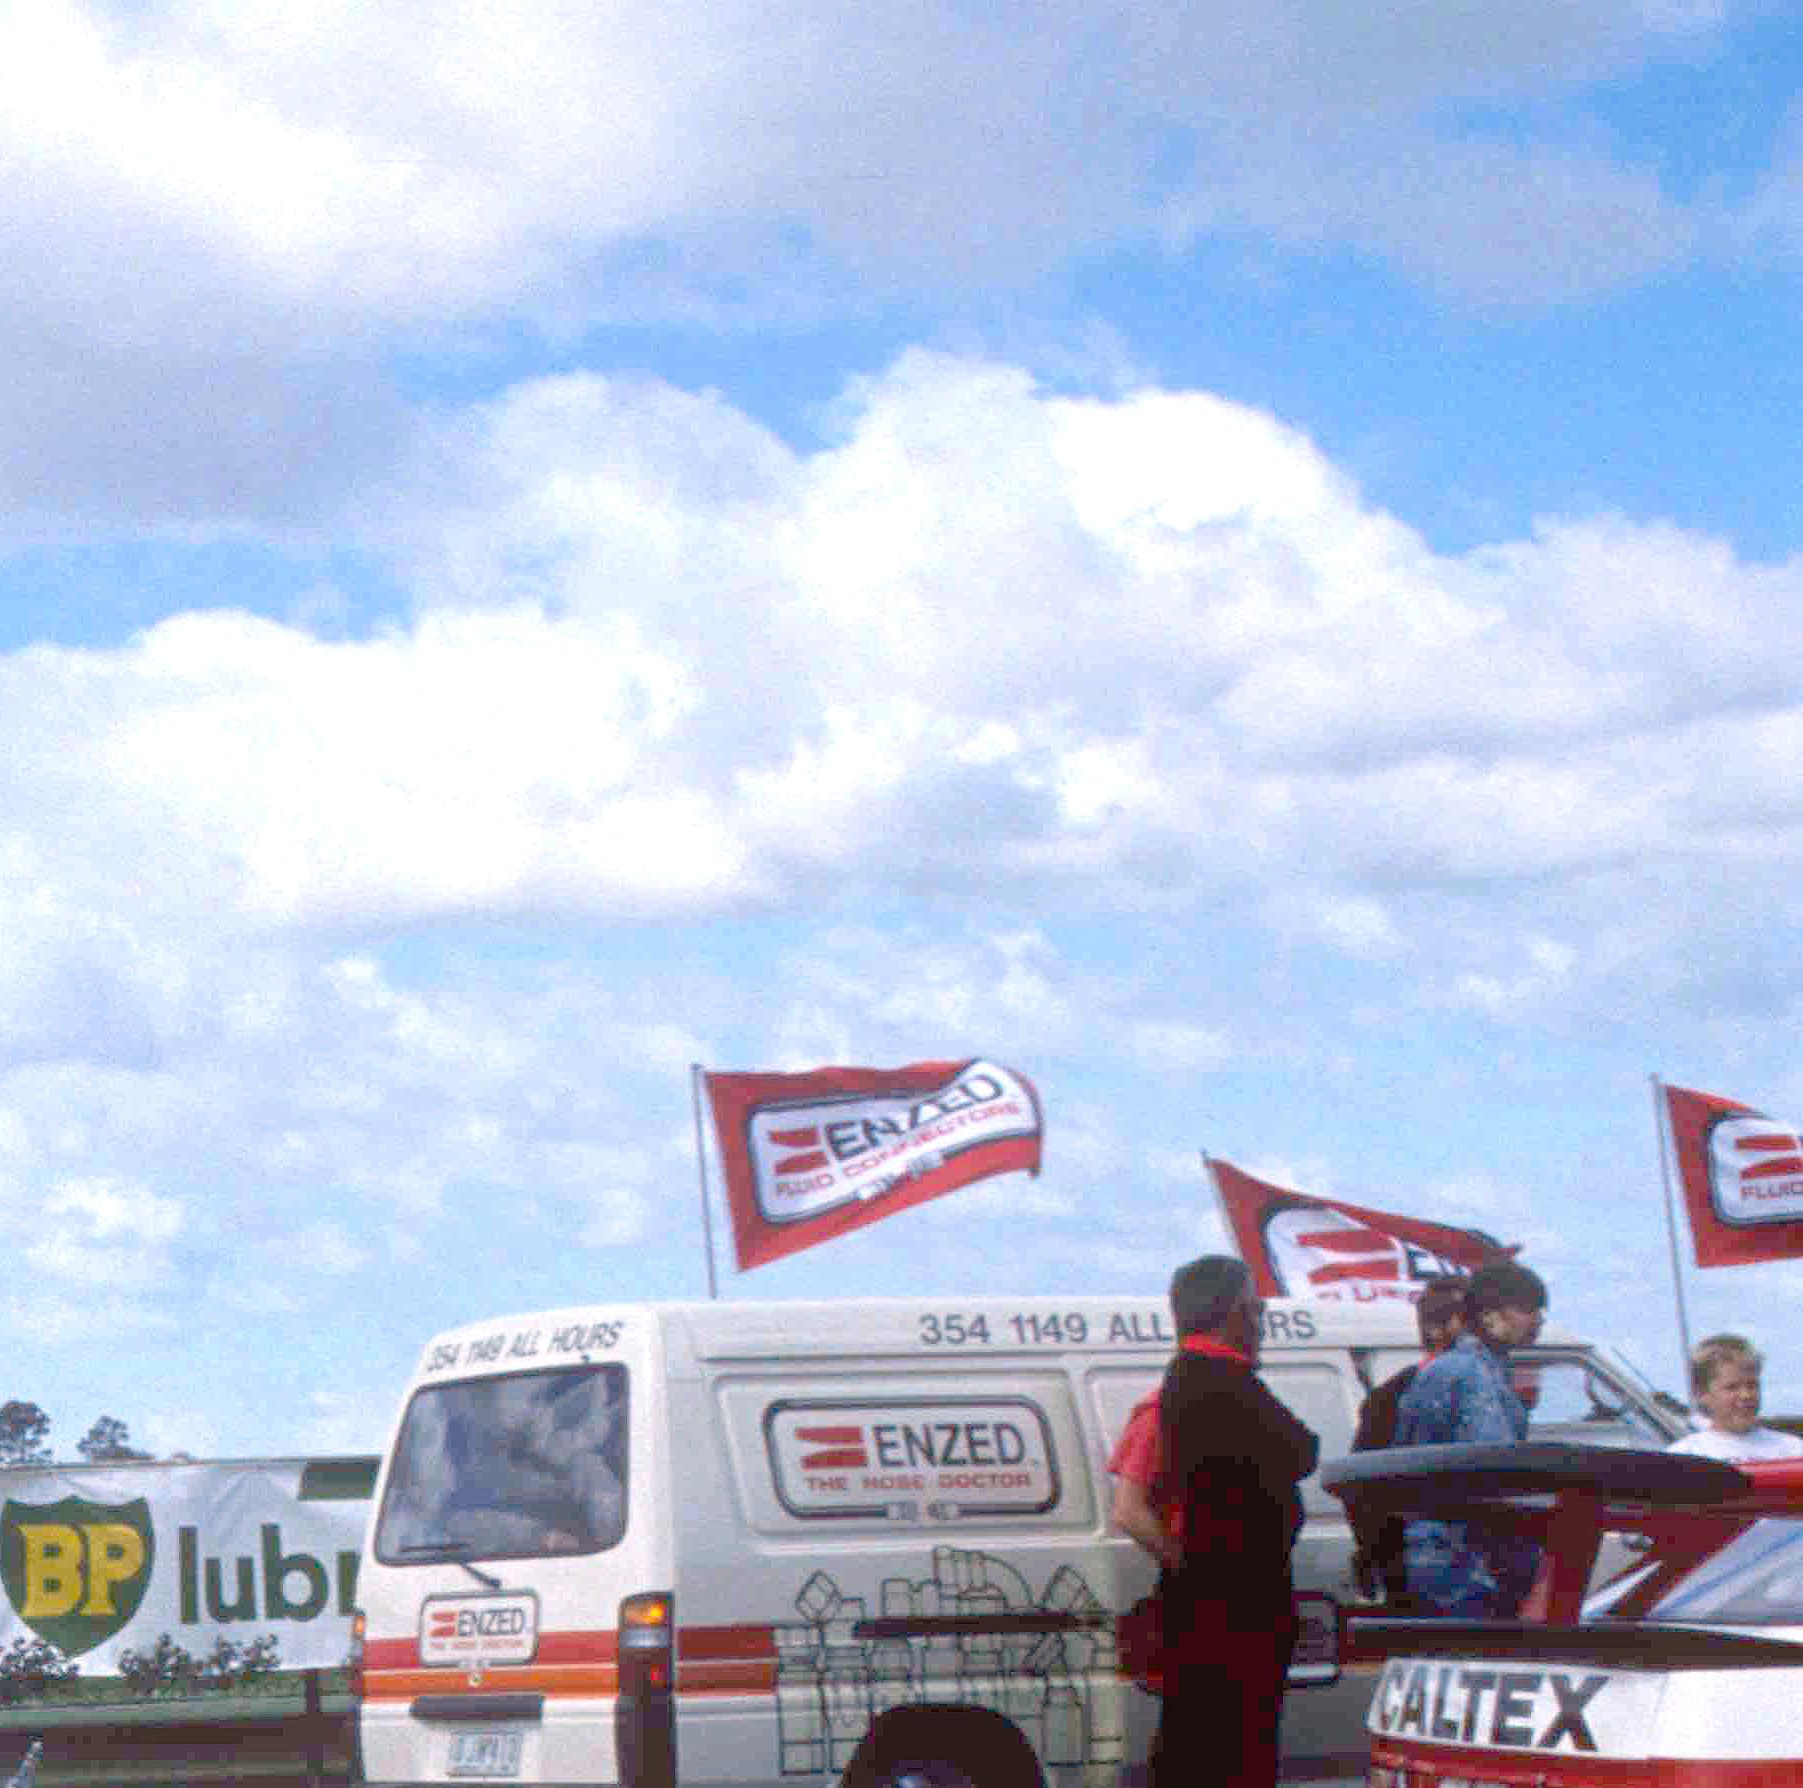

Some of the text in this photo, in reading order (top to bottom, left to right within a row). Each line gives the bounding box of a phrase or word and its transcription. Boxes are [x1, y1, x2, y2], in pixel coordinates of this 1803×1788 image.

[506, 1327, 542, 1359] ALL
[547, 1320, 625, 1352] HOURS
[918, 1312, 991, 1345] 354
[1008, 1311, 1088, 1345] 1149
[1108, 1311, 1174, 1343] ALL
[872, 1422, 1026, 1468] ENZED
[805, 1475, 848, 1491] THE
[938, 1471, 1032, 1489] DOCTOR
[15, 1522, 147, 1617] BP
[458, 1608, 525, 1637] ENZED
[1371, 1662, 1611, 1752] CALTEX
